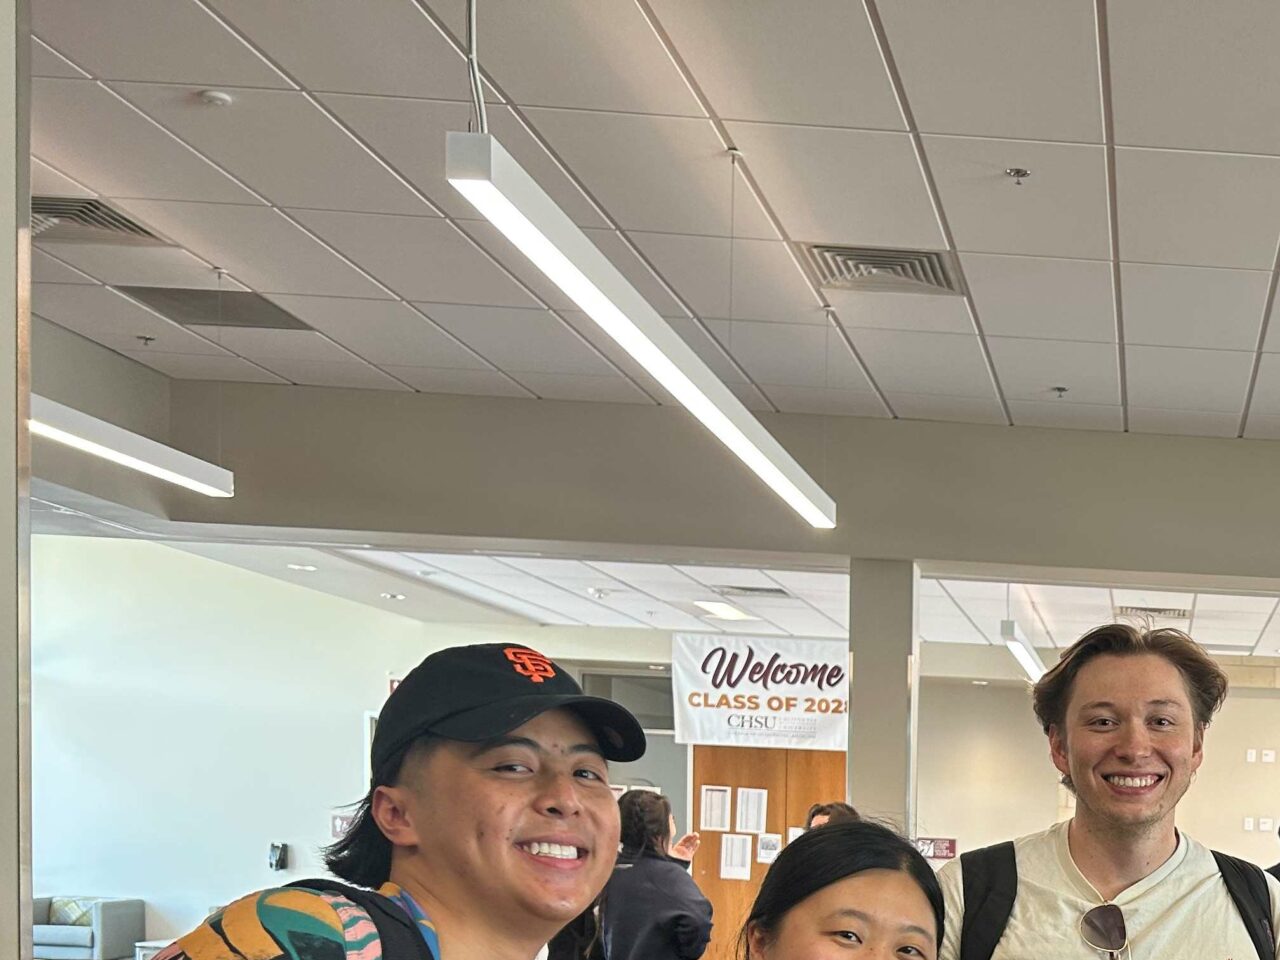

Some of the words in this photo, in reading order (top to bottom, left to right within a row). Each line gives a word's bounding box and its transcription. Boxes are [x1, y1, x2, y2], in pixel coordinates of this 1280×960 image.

[701, 646, 844, 690] Welcome
[688, 692, 760, 711] CLASS
[767, 696, 798, 711] OF
[727, 714, 777, 729] CHSU
